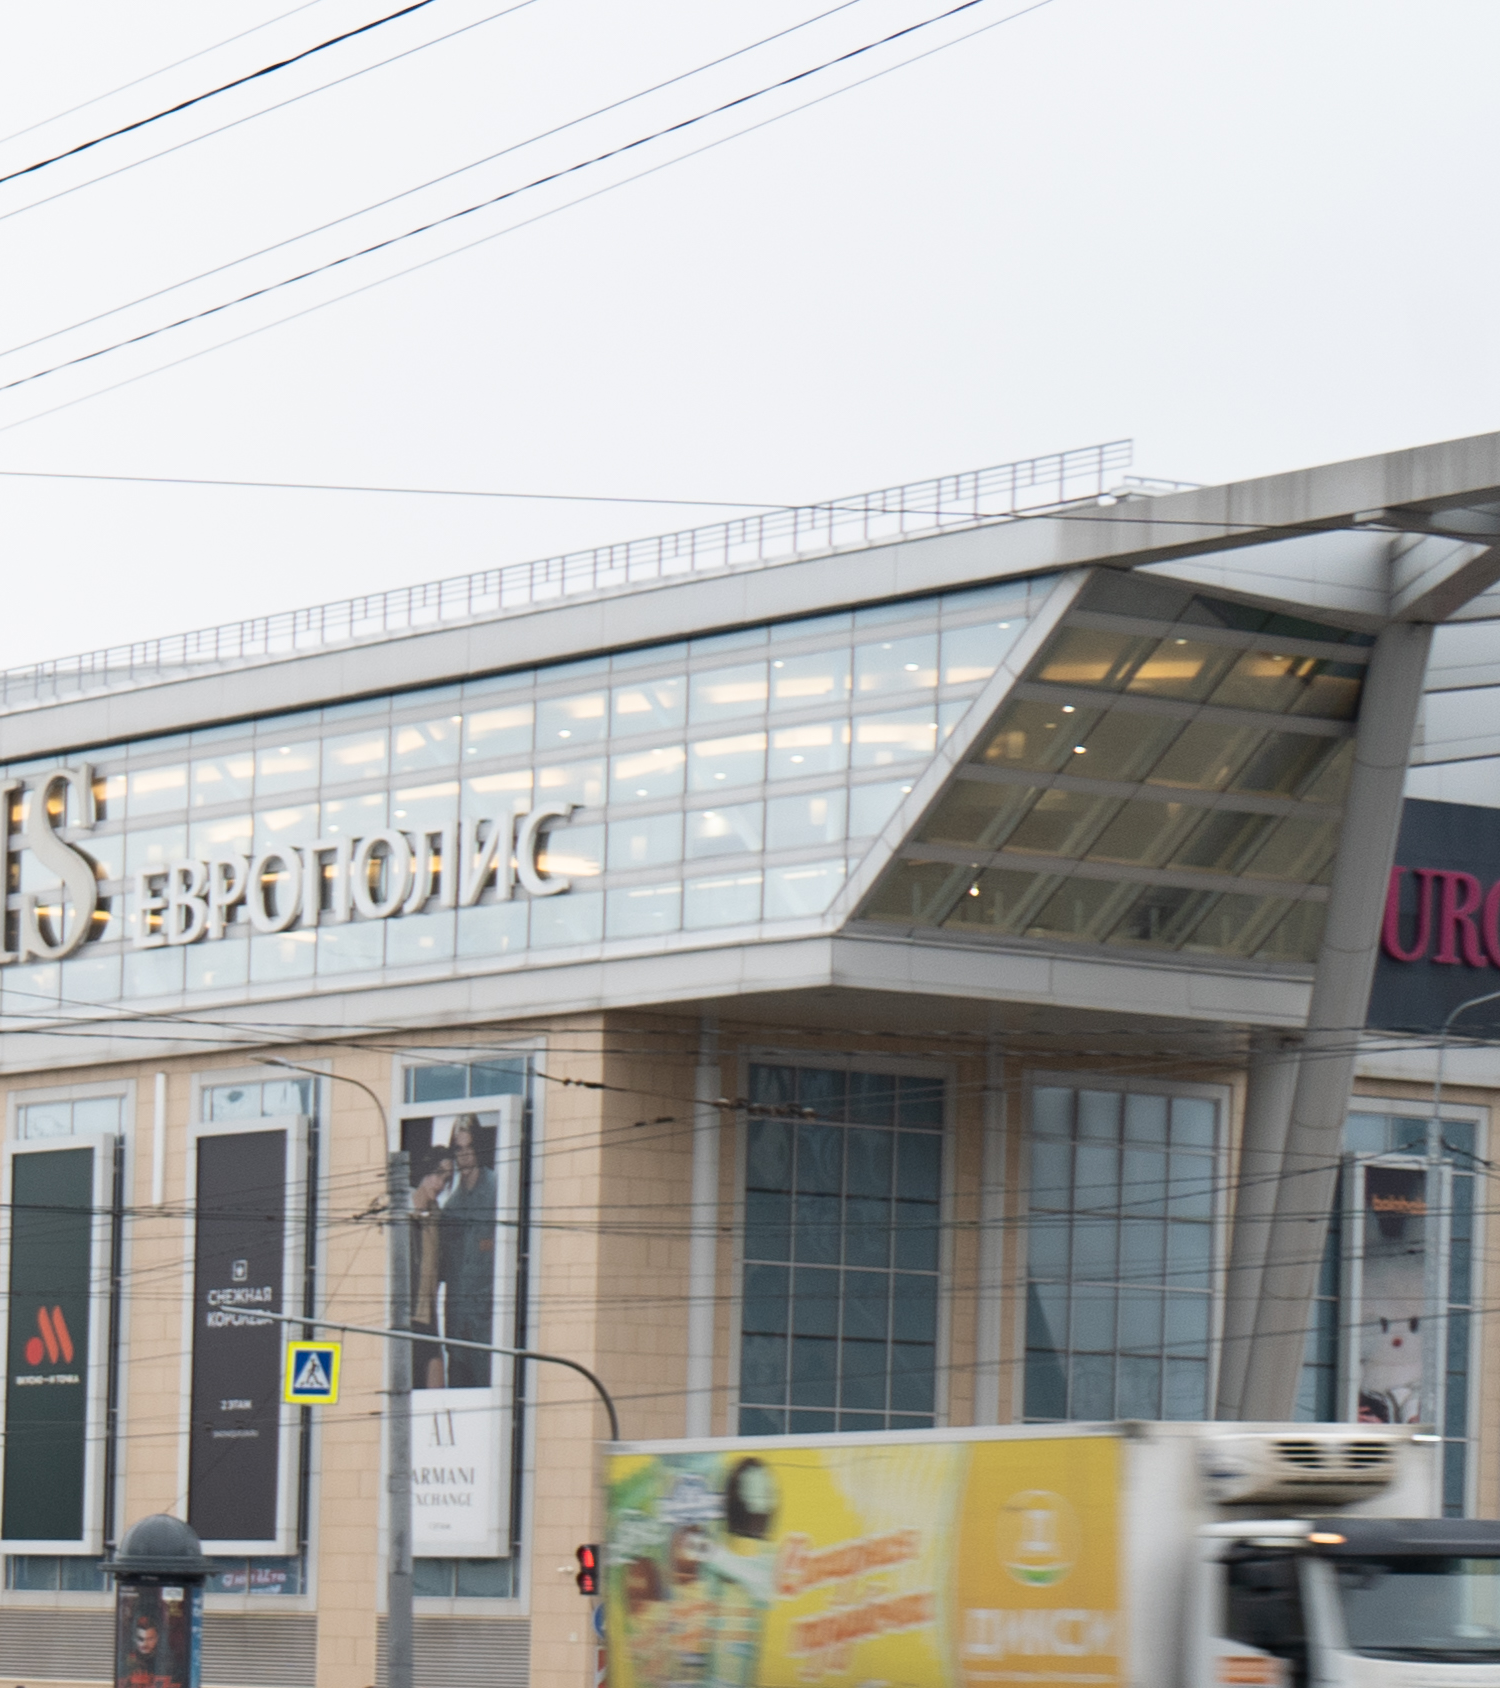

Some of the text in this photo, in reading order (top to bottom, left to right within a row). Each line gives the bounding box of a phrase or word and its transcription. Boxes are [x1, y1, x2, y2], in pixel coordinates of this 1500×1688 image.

[134, 801, 574, 948] ЕВРОПОЛИС
[207, 1286, 273, 1306] СНЕЖНАЯ
[411, 1466, 475, 1486] ARMANI
[412, 1492, 473, 1507] XCHANGE
